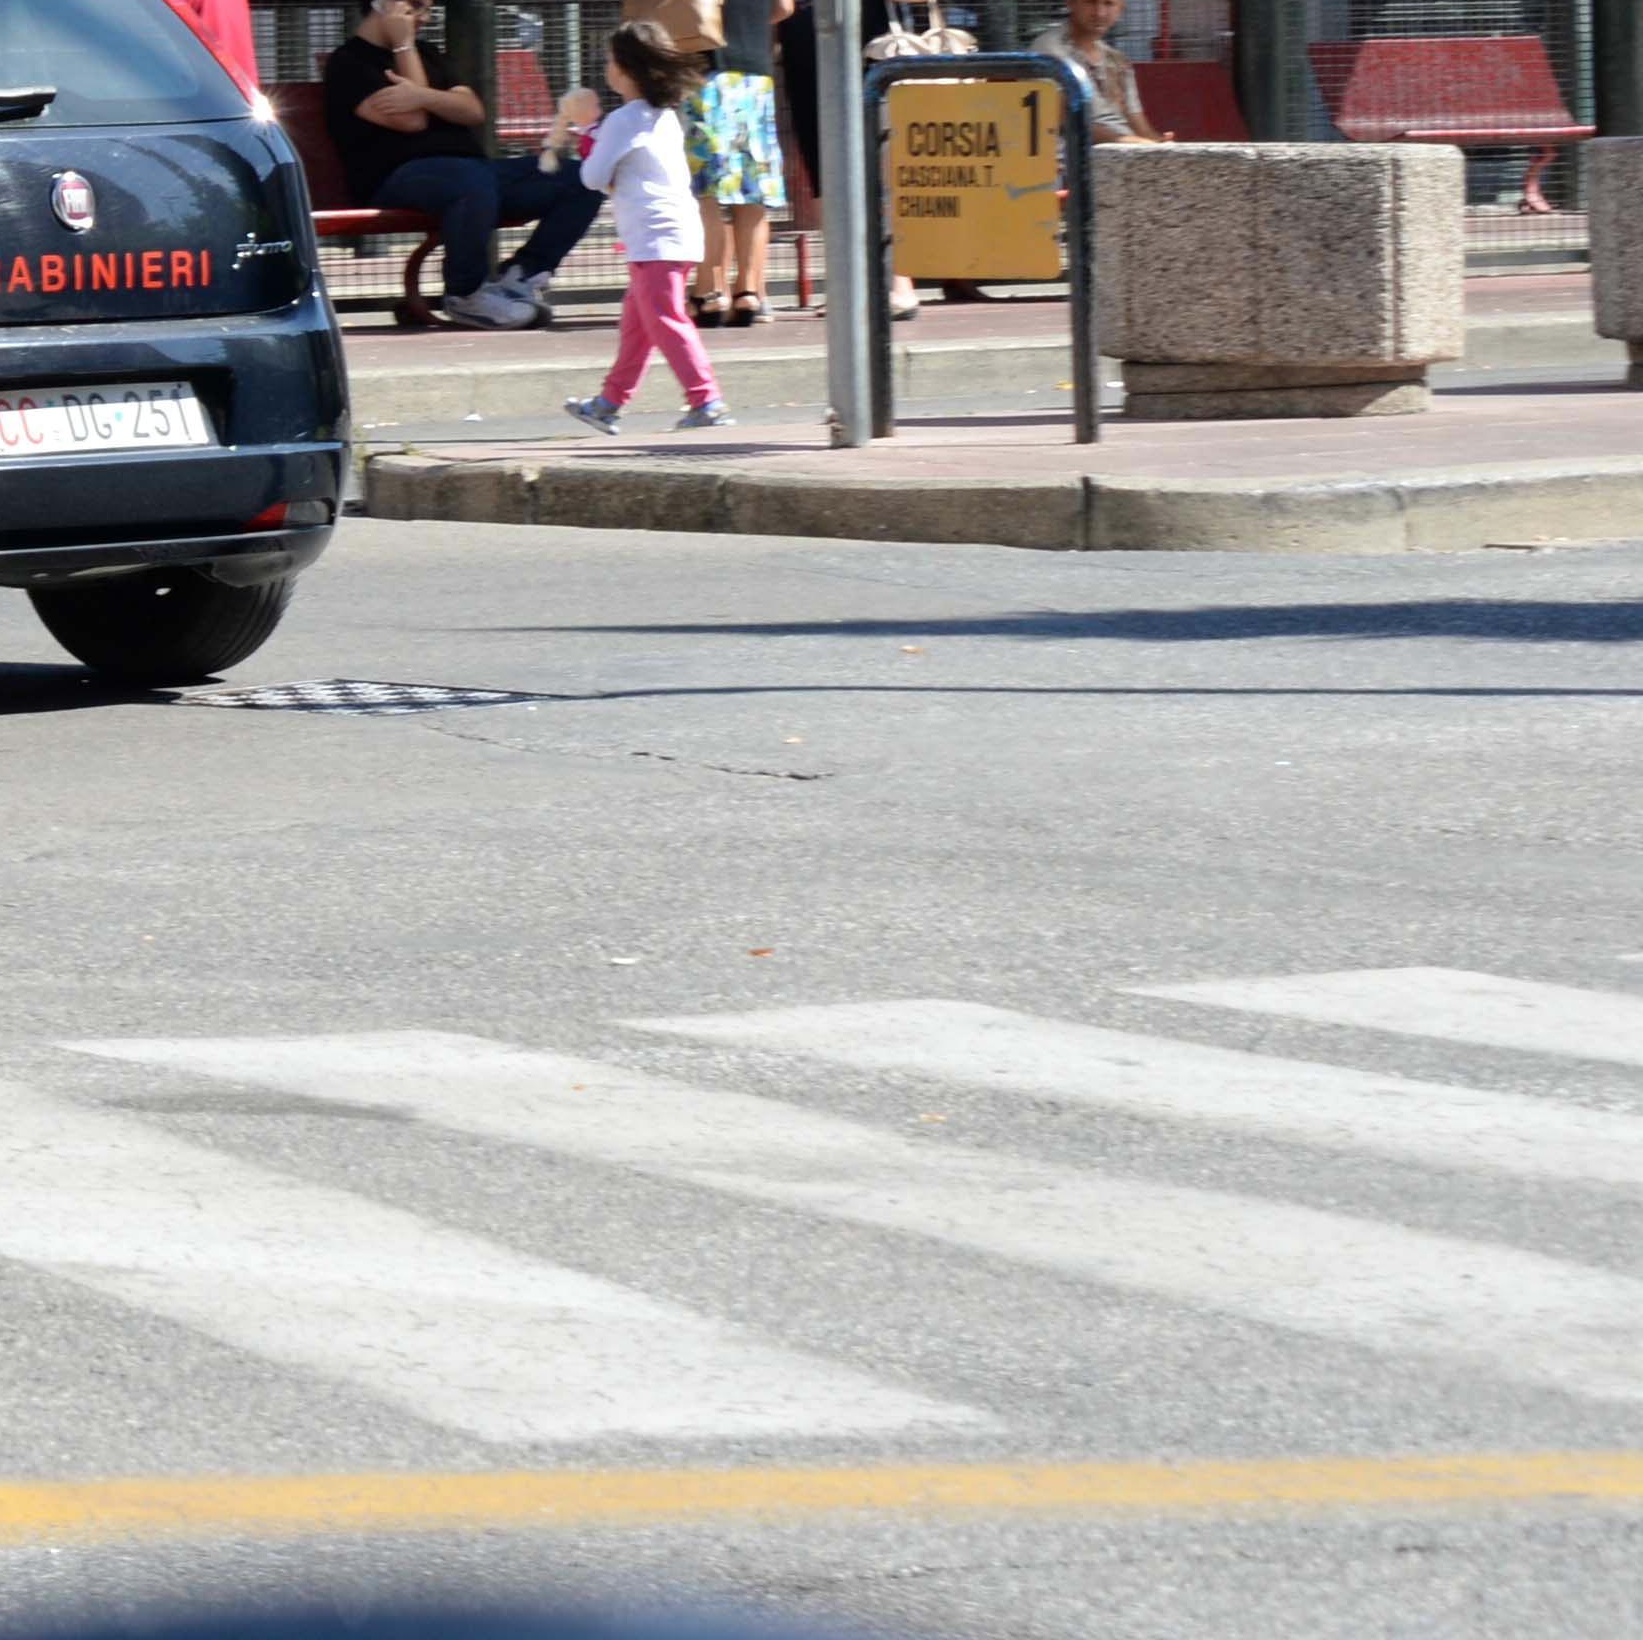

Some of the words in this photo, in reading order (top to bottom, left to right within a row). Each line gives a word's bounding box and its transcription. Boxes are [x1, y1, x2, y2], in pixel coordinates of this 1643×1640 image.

[908, 122, 1001, 157] CORSIA
[1021, 89, 1040, 157] 1
[898, 196, 961, 218] CHIANNI
[62, 392, 113, 442] DG
[124, 389, 192, 441] 251
